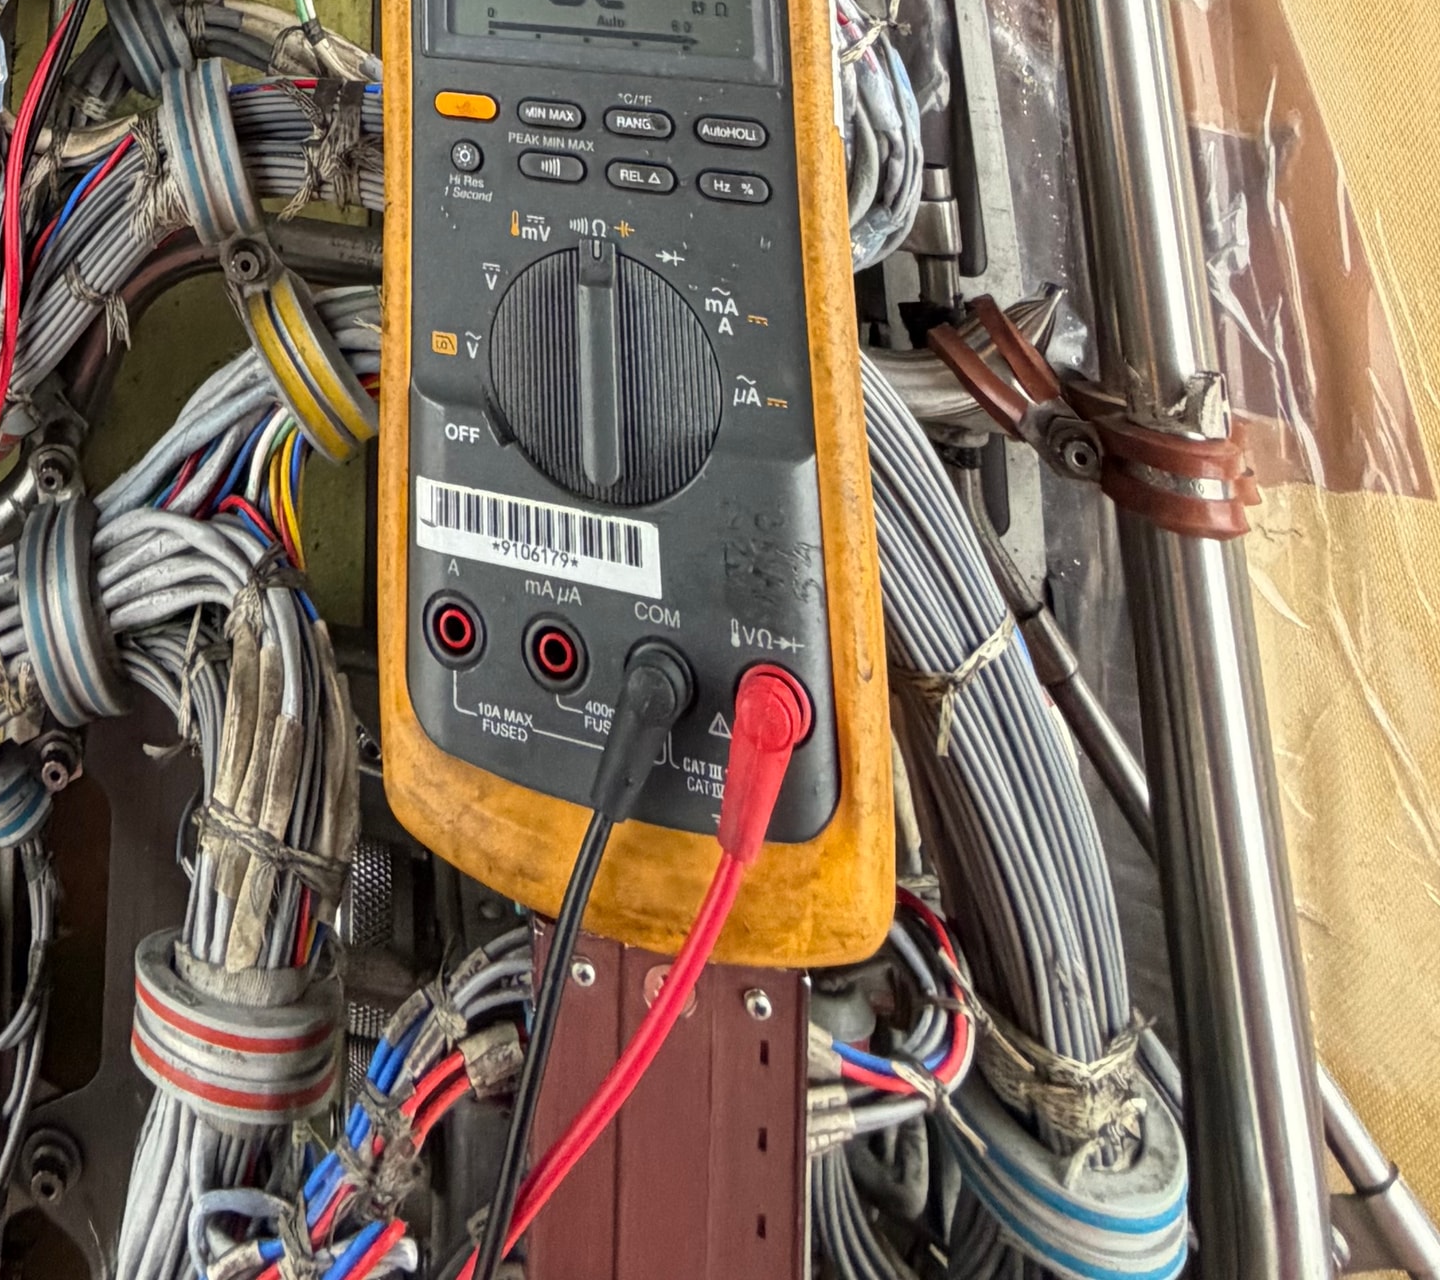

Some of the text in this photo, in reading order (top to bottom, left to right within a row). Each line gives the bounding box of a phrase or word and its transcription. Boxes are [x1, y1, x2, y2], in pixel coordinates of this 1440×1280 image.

[596, 15, 626, 28] Auto
[525, 107, 574, 123] MIN MAX
[616, 116, 662, 131] RANG
[508, 132, 595, 153] PEAK MIN MAX
[463, 175, 485, 188] Res
[620, 170, 645, 183] REL
[713, 179, 731, 193] Hz
[452, 188, 492, 203] Second
[521, 226, 551, 242] mV
[485, 273, 497, 290] V
[705, 298, 739, 316] mA
[718, 317, 733, 336] A
[466, 341, 479, 359] V
[445, 423, 480, 443] OFF
[447, 558, 460, 577] A
[525, 579, 554, 600] mA
[634, 601, 681, 629] COM
[477, 701, 534, 729] 10A MAX
[482, 719, 528, 743] FUSED
[584, 715, 612, 735] FUS
[683, 757, 706, 775] CAT
[686, 776, 710, 794] CAT
